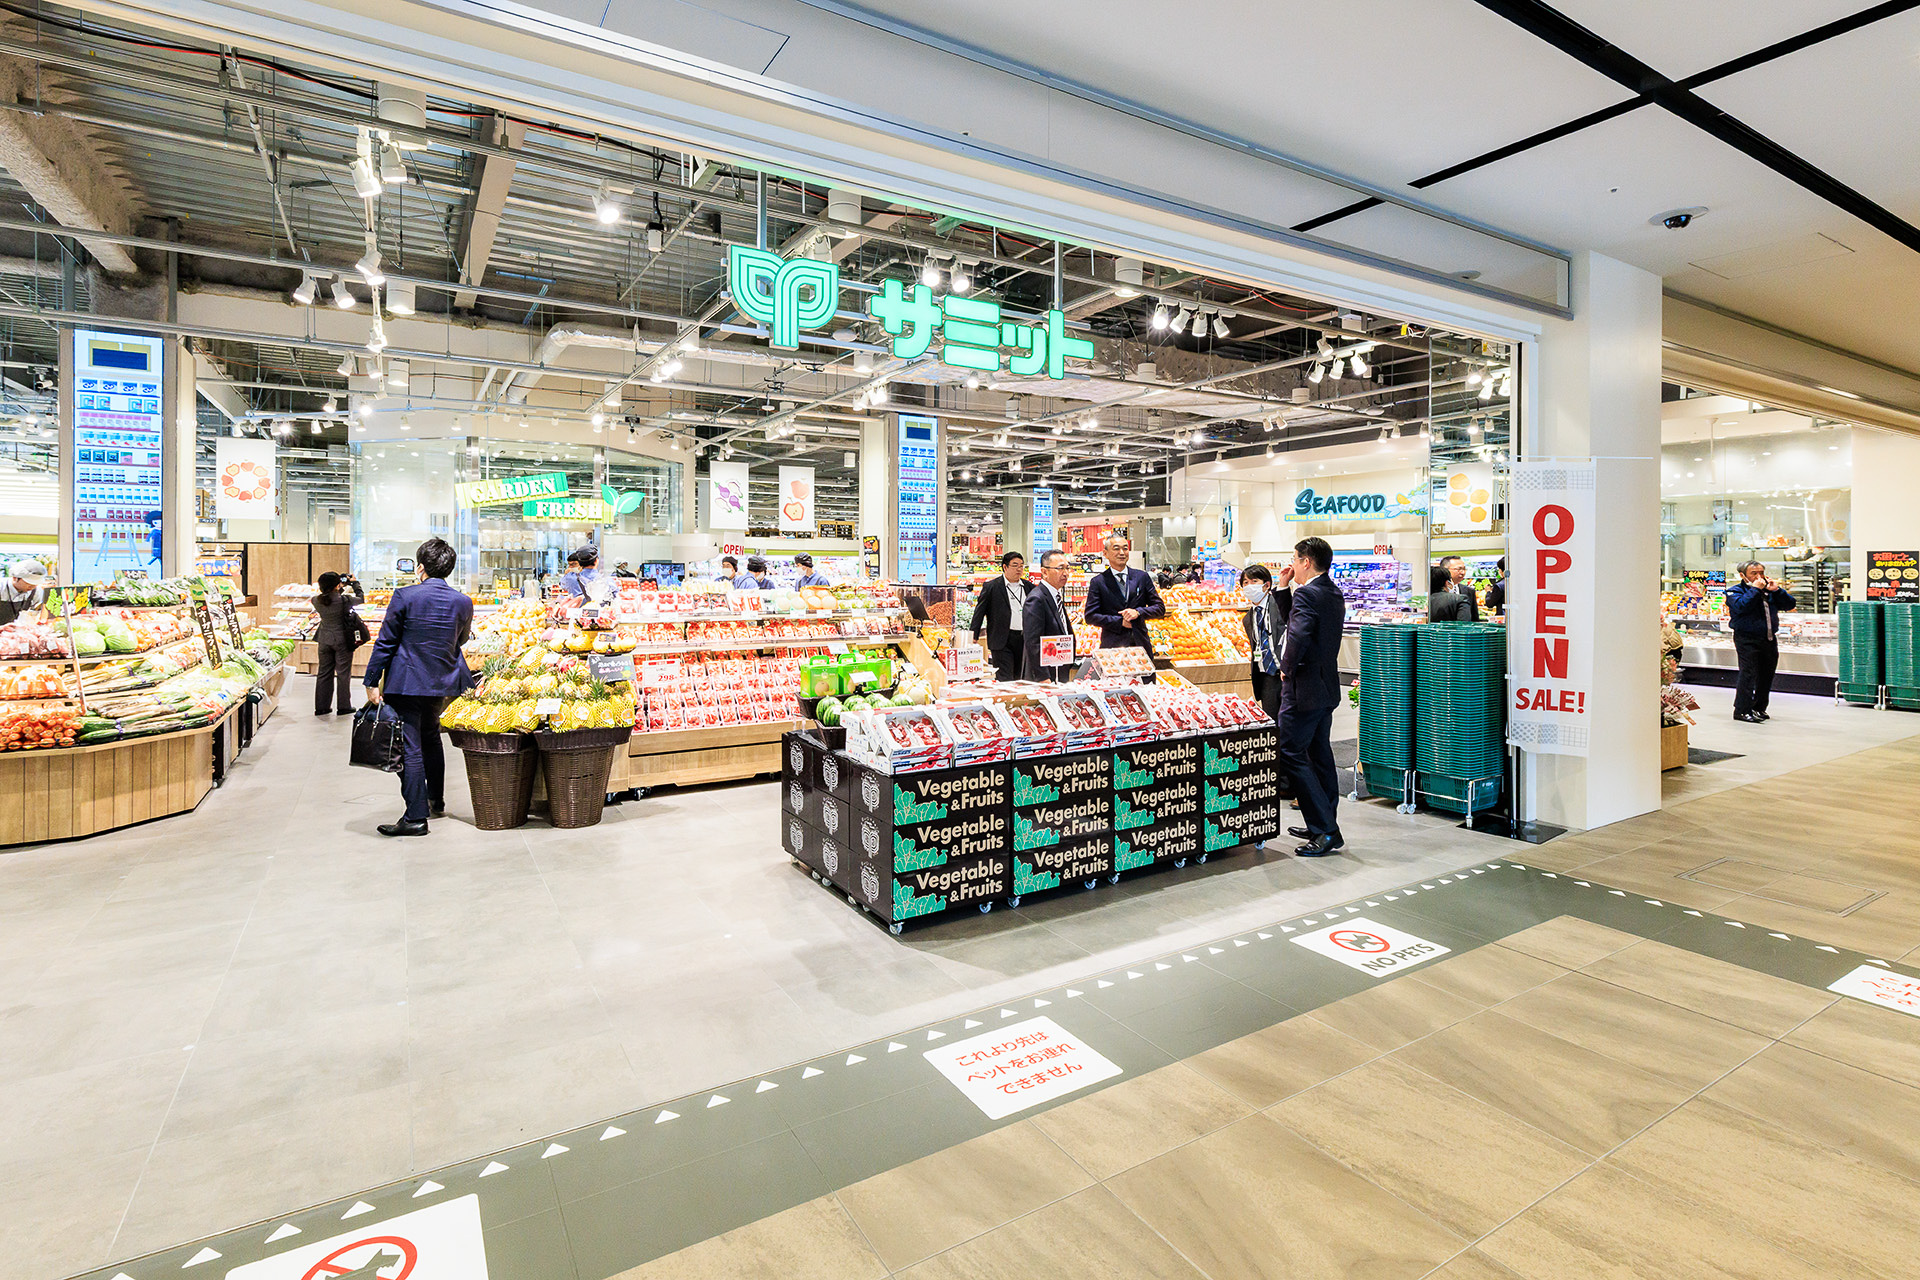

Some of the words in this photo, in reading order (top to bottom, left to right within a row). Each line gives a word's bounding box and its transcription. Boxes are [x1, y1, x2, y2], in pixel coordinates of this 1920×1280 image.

[870, 278, 1094, 380] サミット
[470, 478, 556, 503] GARDEN
[1295, 488, 1385, 514] SEAFOOD
[536, 502, 602, 520] FRESH
[723, 544, 744, 555] OPEN
[1532, 504, 1575, 679] OPEN
[1515, 688, 1585, 714] SALE!
[1131, 743, 1197, 767] Vegetable
[1219, 731, 1277, 754] Vegetable
[1033, 755, 1109, 783] Vegetable
[1219, 768, 1277, 792] Vegetable
[917, 769, 1004, 800] Vegetable
[1131, 782, 1197, 807] Vegetable
[1034, 798, 1109, 826] Vegetable
[1220, 805, 1277, 829] Vegetable
[918, 814, 1004, 845] Vegetable
[1131, 820, 1197, 847] Vegetable
[1034, 840, 1109, 868] Vegetable
[916, 858, 1003, 890] Vegetable
[1361, 957, 1398, 971] NO
[1392, 943, 1435, 961] PETS
[955, 1031, 1049, 1067] これより先は
[967, 1042, 1076, 1082] ペットをお連れ
[996, 1062, 1083, 1095] できません
